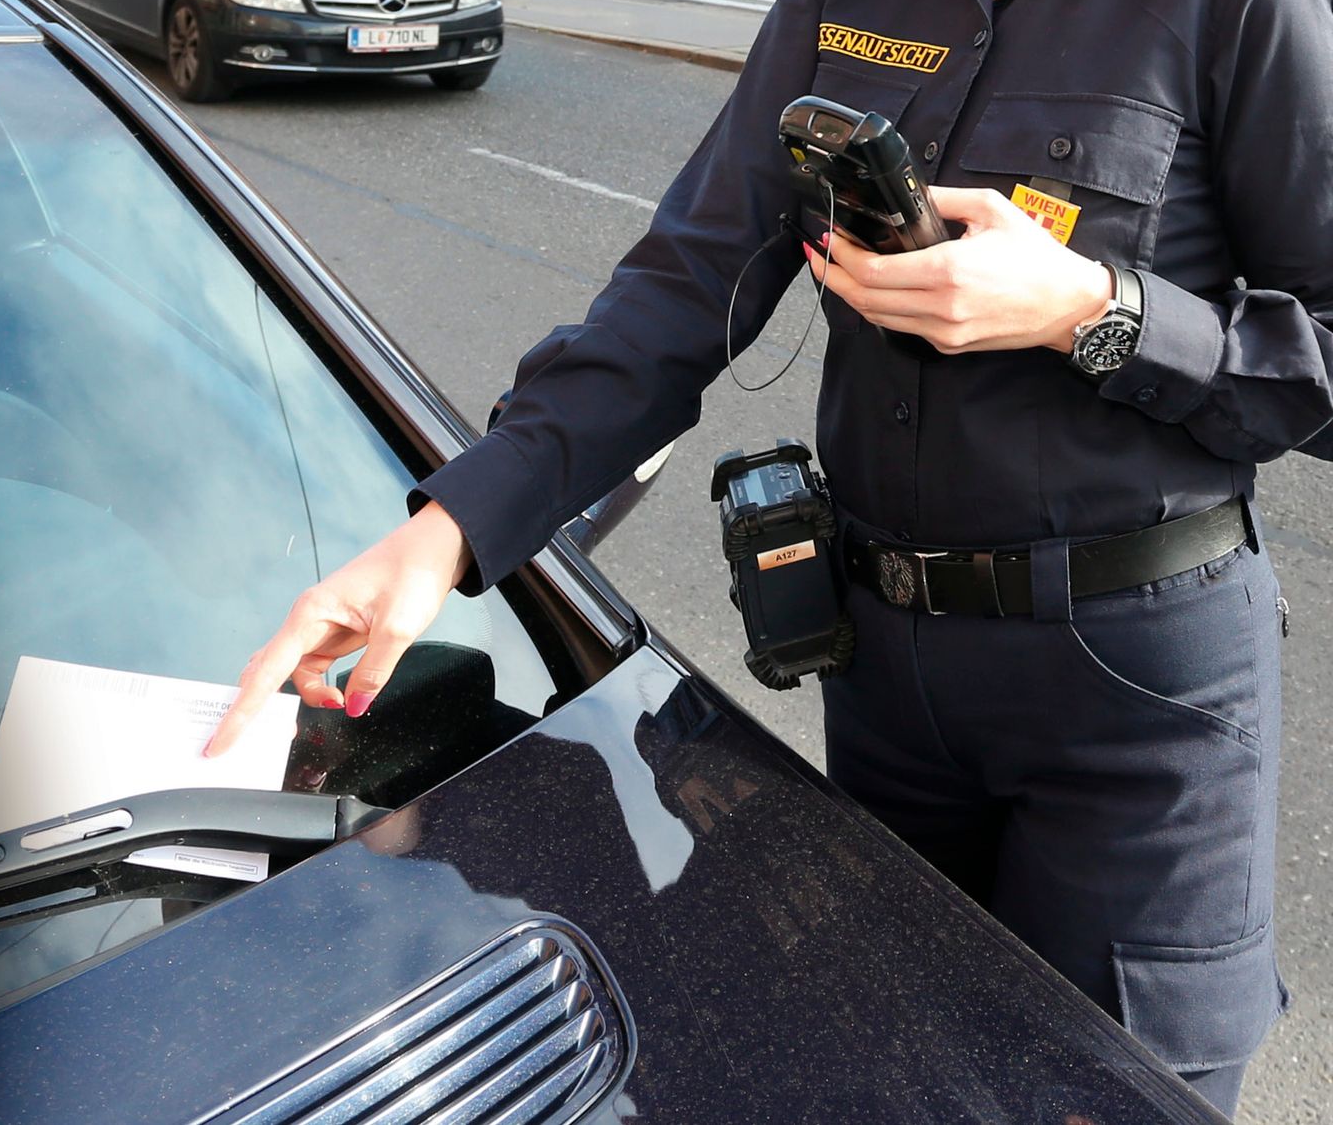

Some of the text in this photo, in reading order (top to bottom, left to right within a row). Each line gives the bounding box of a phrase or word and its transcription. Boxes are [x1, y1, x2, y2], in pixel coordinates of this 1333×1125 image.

[387, 30, 410, 44] 710
[413, 29, 428, 43] NL
[1025, 192, 1066, 218] WIEN
[776, 550, 796, 561] A127
